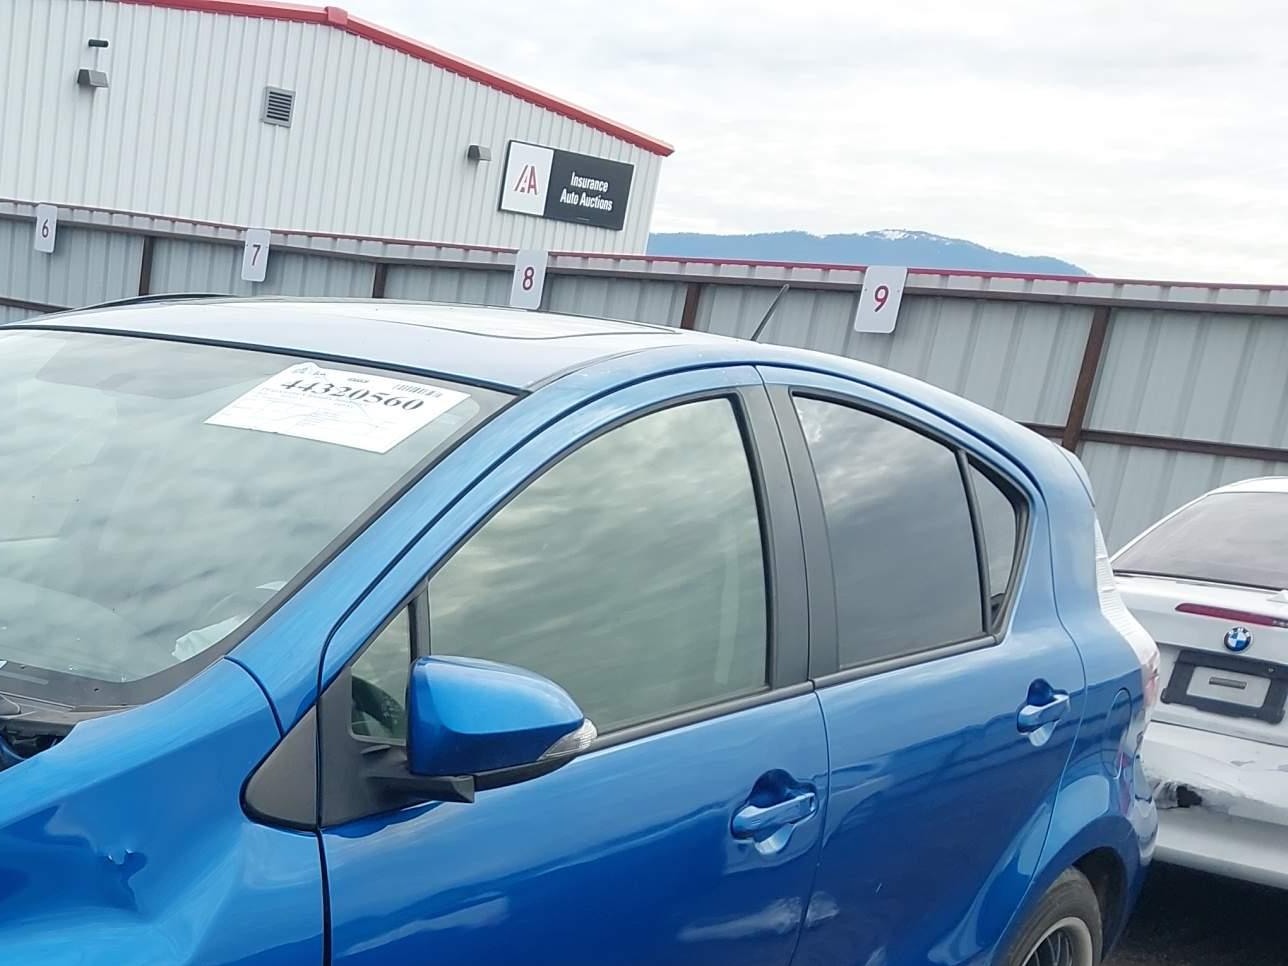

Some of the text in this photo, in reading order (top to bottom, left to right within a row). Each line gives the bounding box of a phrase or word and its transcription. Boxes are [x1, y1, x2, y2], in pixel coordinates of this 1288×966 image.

[570, 171, 609, 192] Insurance
[559, 188, 613, 211] Auto Auctions
[42, 218, 49, 238] 6
[252, 244, 261, 266] 7
[523, 266, 535, 290] 8
[874, 285, 889, 312] 9
[281, 379, 424, 410] 44320560
